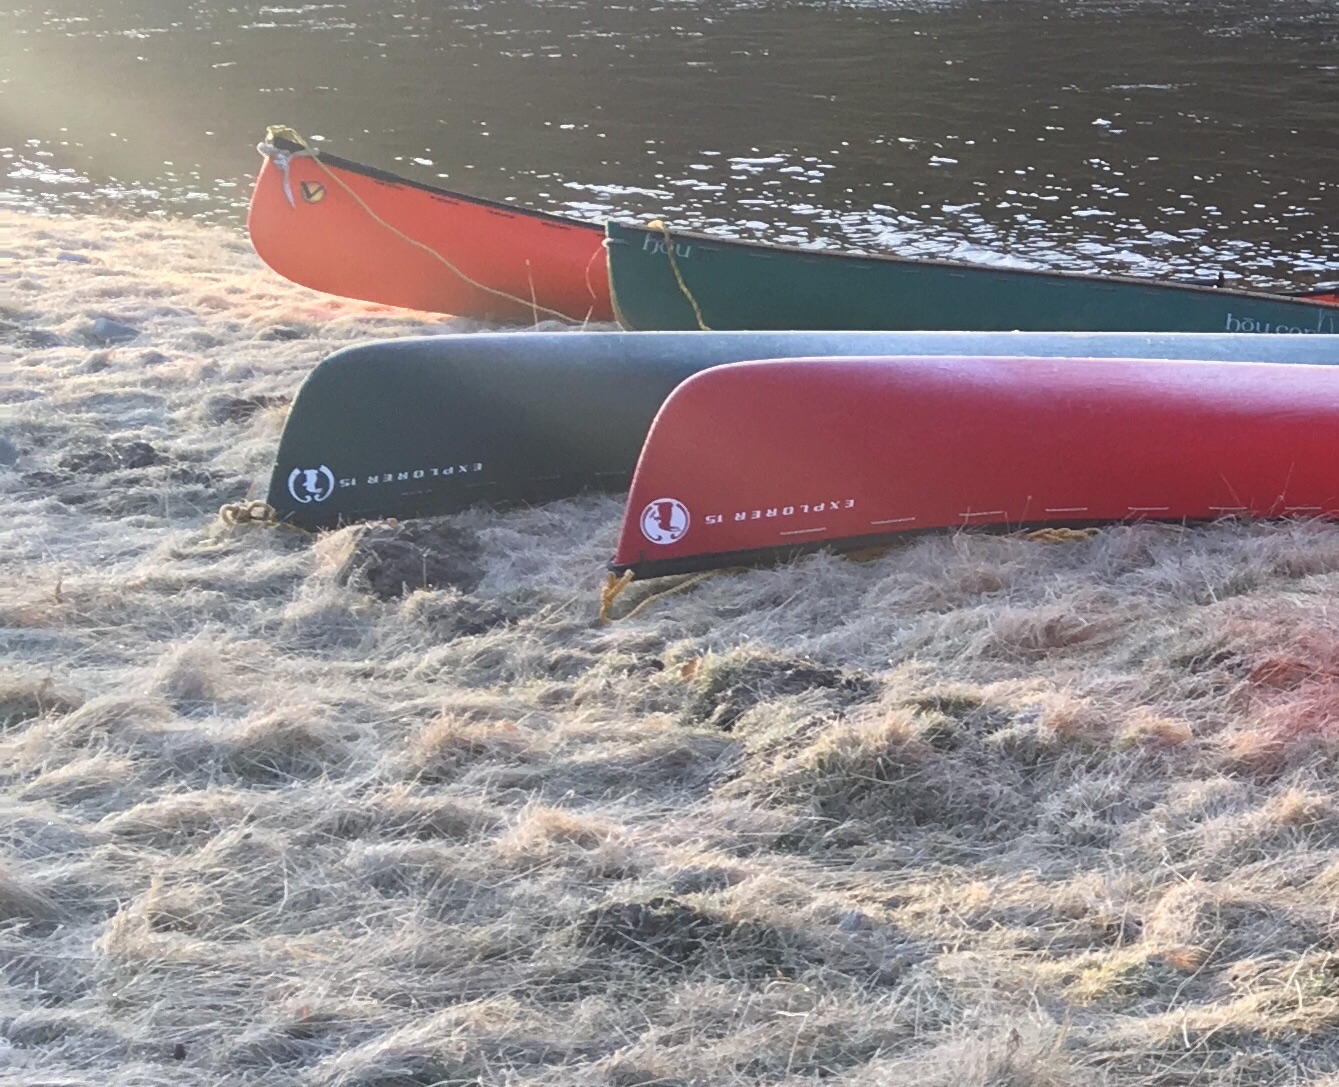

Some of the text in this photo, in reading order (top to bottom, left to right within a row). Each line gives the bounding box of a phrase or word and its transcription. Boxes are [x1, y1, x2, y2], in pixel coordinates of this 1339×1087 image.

[339, 462, 483, 488] EXPLORER 15
[705, 499, 855, 525] EXPLORER 15
